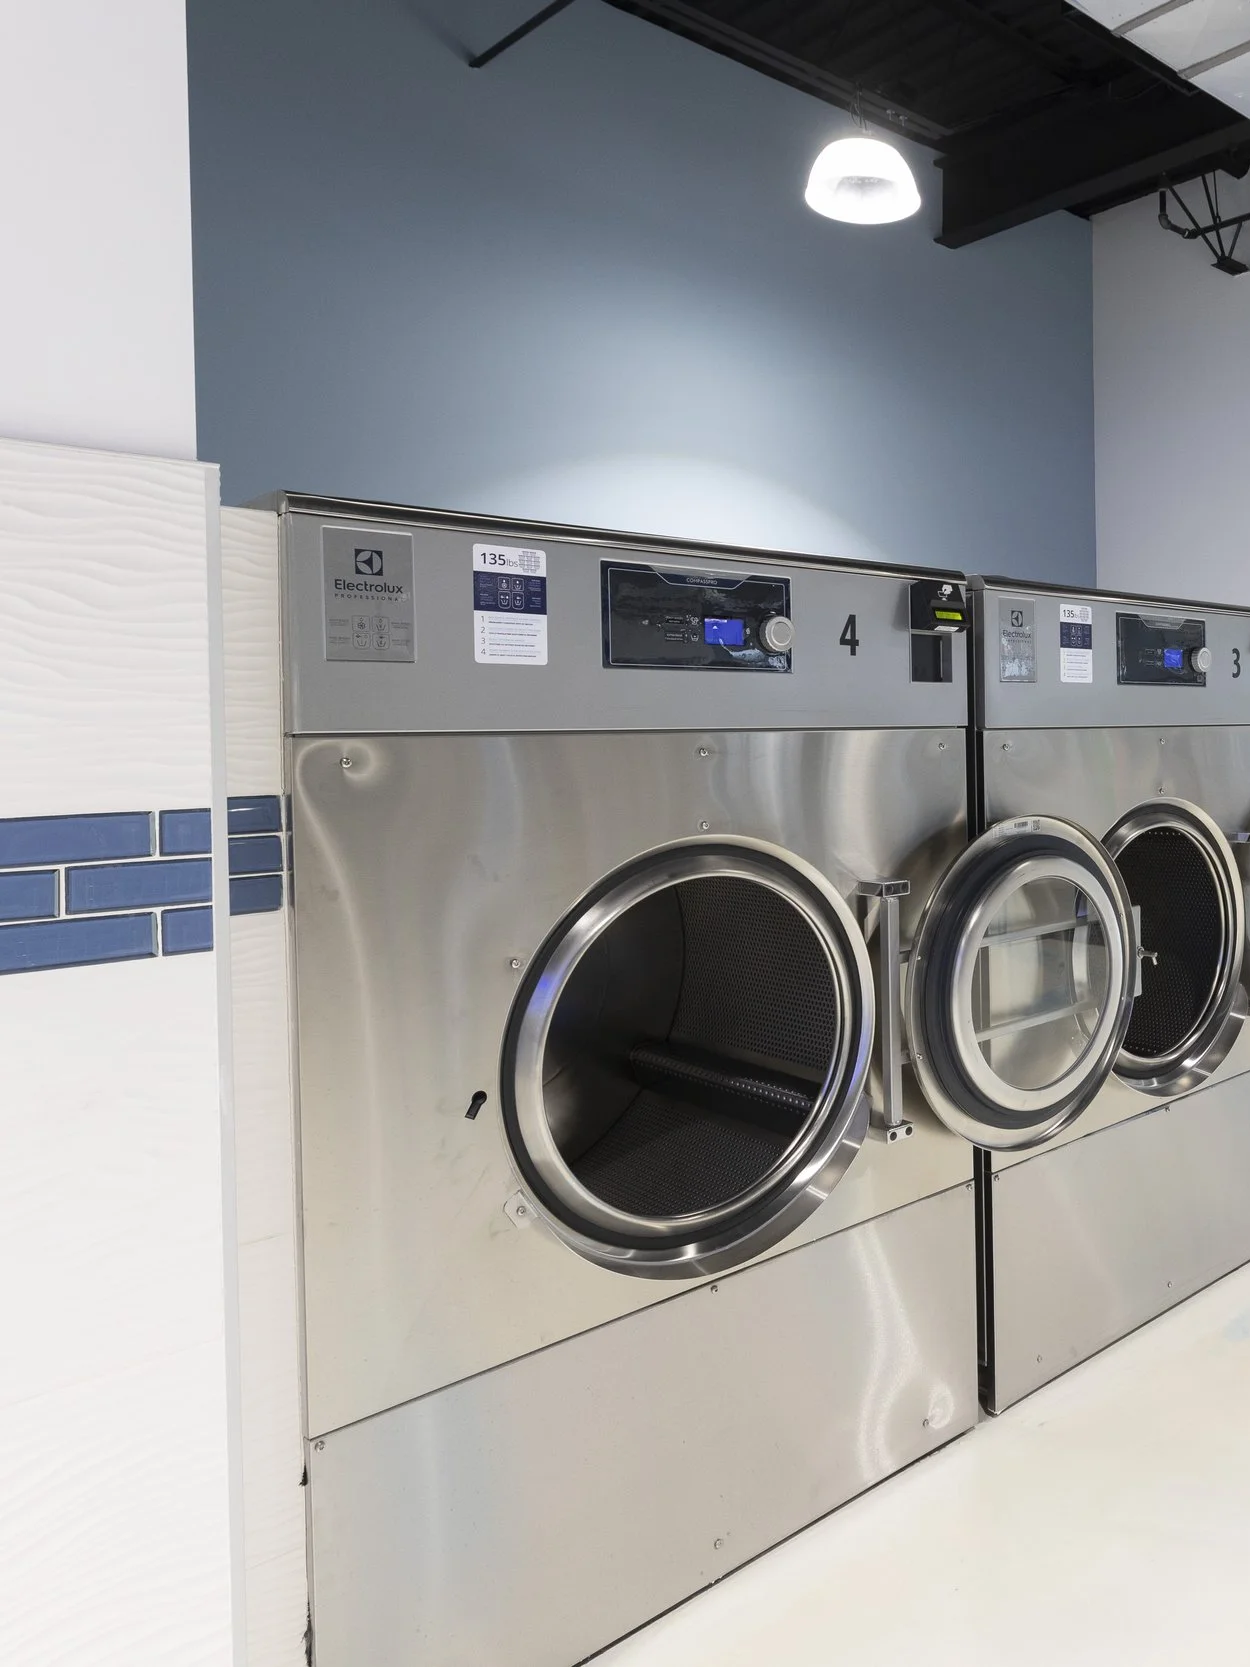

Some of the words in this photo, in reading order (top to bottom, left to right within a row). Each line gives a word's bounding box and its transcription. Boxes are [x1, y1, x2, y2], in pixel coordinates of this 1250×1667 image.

[334, 579, 403, 594] Electrolux
[334, 593, 408, 602] PROFESSIONA
[839, 614, 860, 656] 4
[1002, 629, 1032, 639] Electrolux
[1231, 648, 1241, 679] 3
